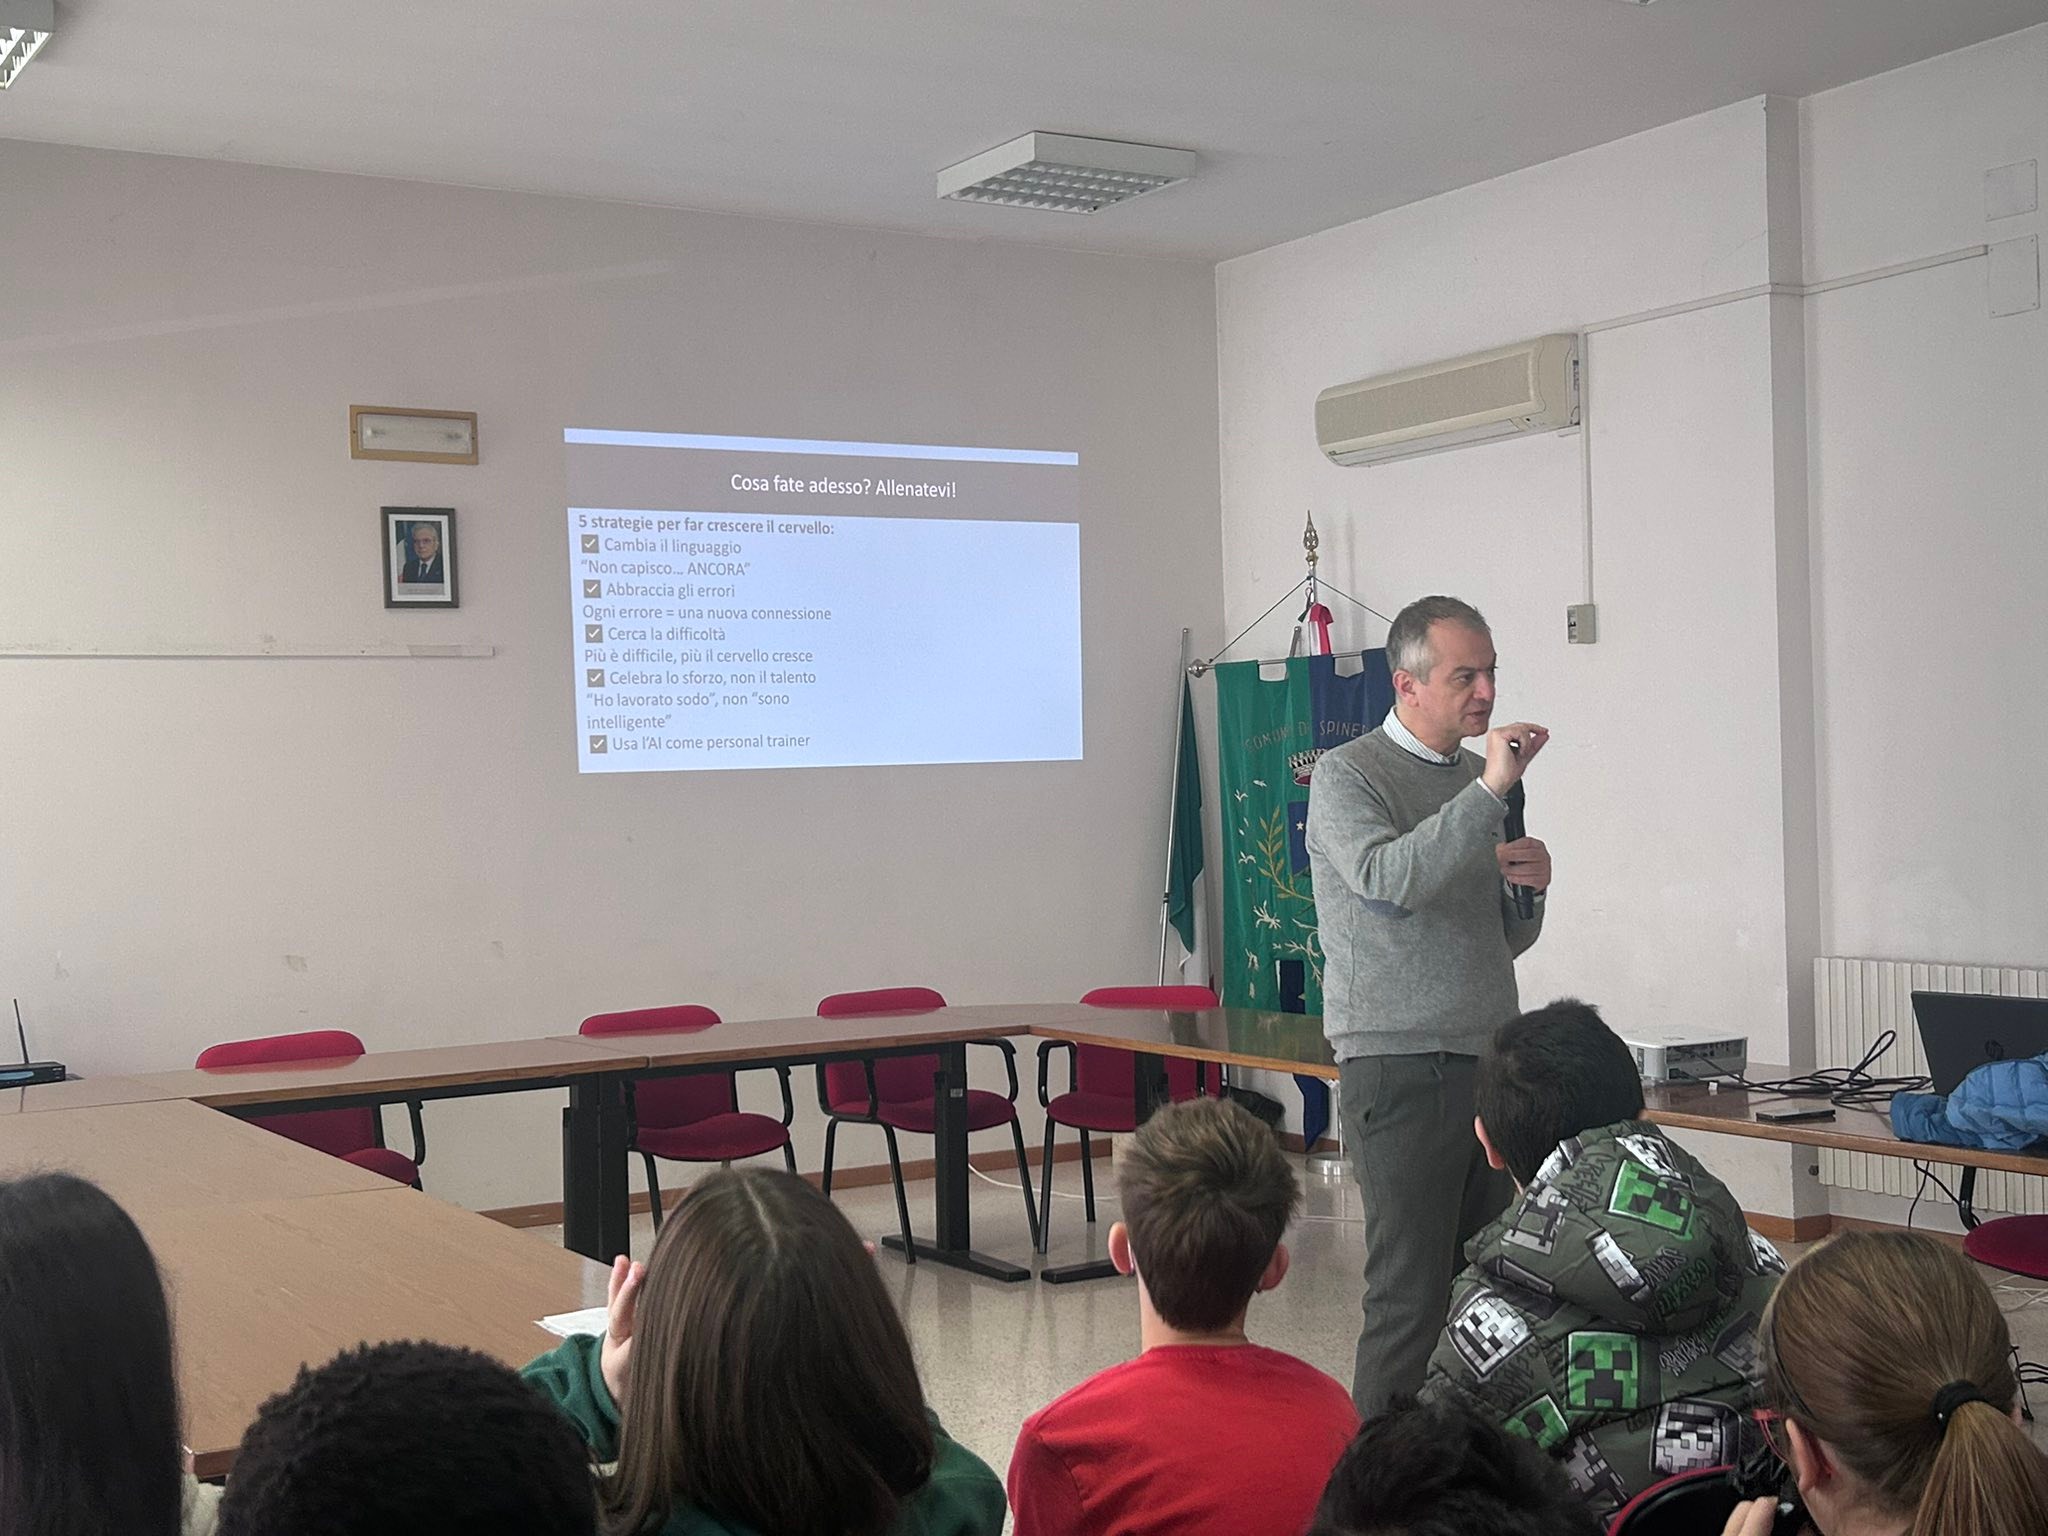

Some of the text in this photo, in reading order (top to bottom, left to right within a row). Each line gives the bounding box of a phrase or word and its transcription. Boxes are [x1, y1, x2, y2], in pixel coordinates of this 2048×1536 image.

[731, 473, 956, 497] Cosa fate adesso? Allenatevi!
[578, 515, 835, 535] 5 strategie per far crescere il cervello:
[605, 538, 741, 556] Cambia il linguaggio
[606, 583, 735, 600] Abbraccia gli errori
[583, 605, 616, 621] Ogni
[619, 607, 662, 618] errore
[679, 609, 703, 619] una
[707, 609, 747, 619] nuova
[751, 607, 832, 620] connessione
[608, 626, 726, 640] Cerca la difficoltà
[585, 649, 813, 665] Più è difficile, più il cervello cresce
[610, 671, 816, 686] Celebra lo sforzo, non il talento
[617, 693, 673, 706] lavorato
[722, 695, 748, 705] non
[612, 737, 638, 750] Usa
[666, 739, 703, 749] come
[707, 735, 763, 751] personal
[767, 736, 810, 747] trainer
[1244, 726, 1292, 752] COMUN
